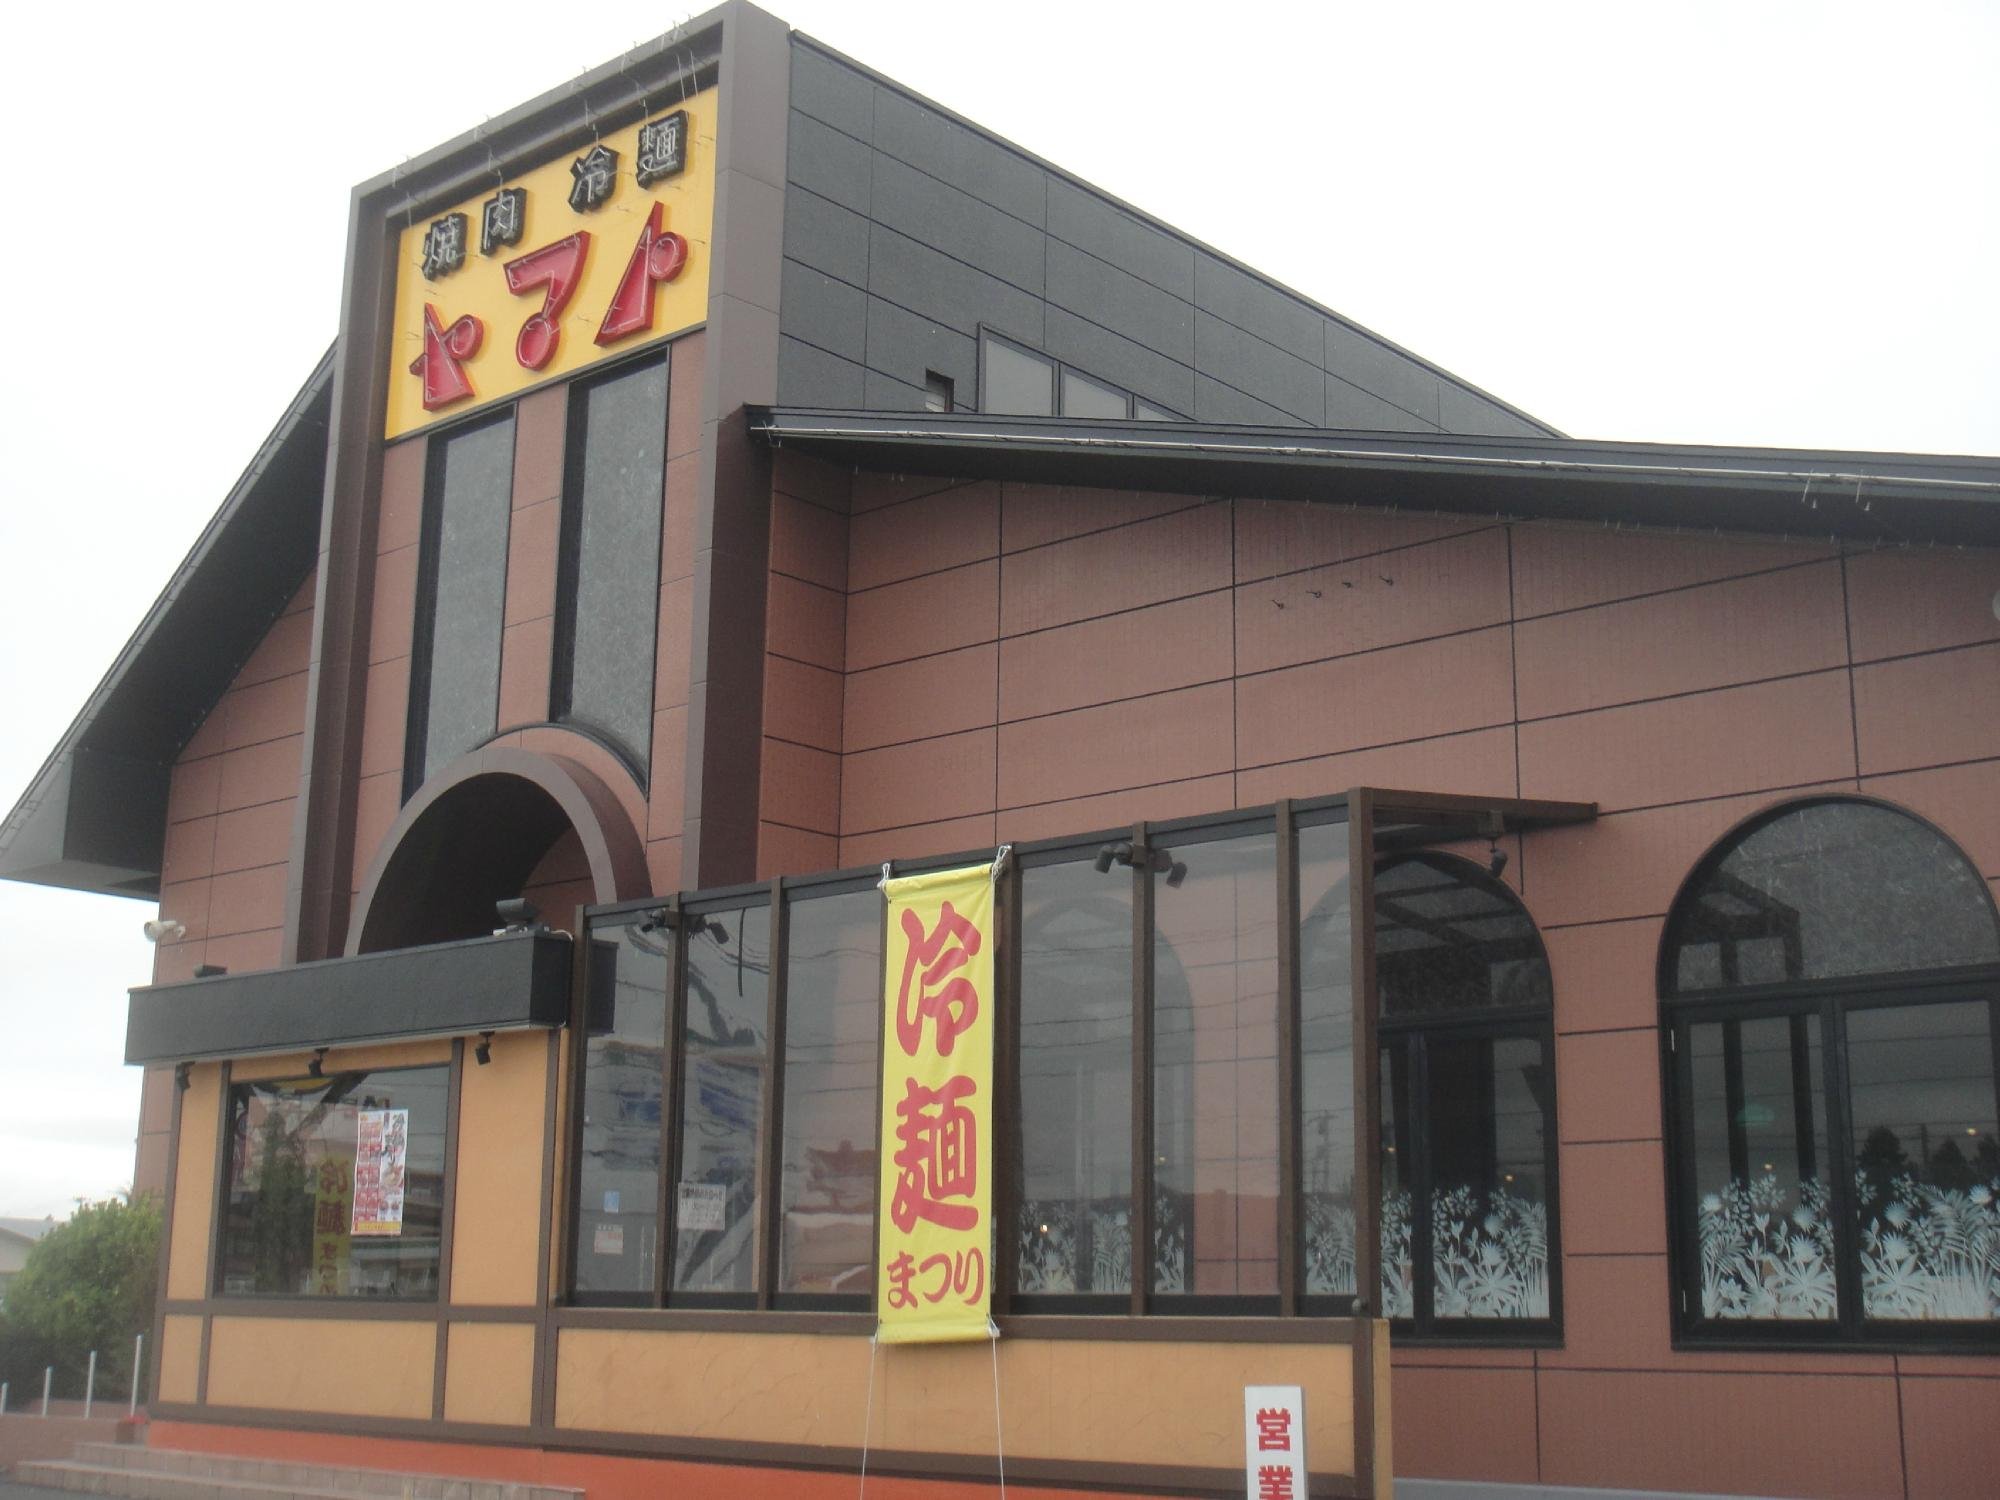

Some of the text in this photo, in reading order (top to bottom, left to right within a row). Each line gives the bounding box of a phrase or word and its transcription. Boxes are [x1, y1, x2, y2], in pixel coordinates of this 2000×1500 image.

[891, 901, 981, 1234] 冷麺
[886, 1246, 984, 1309] まつり
